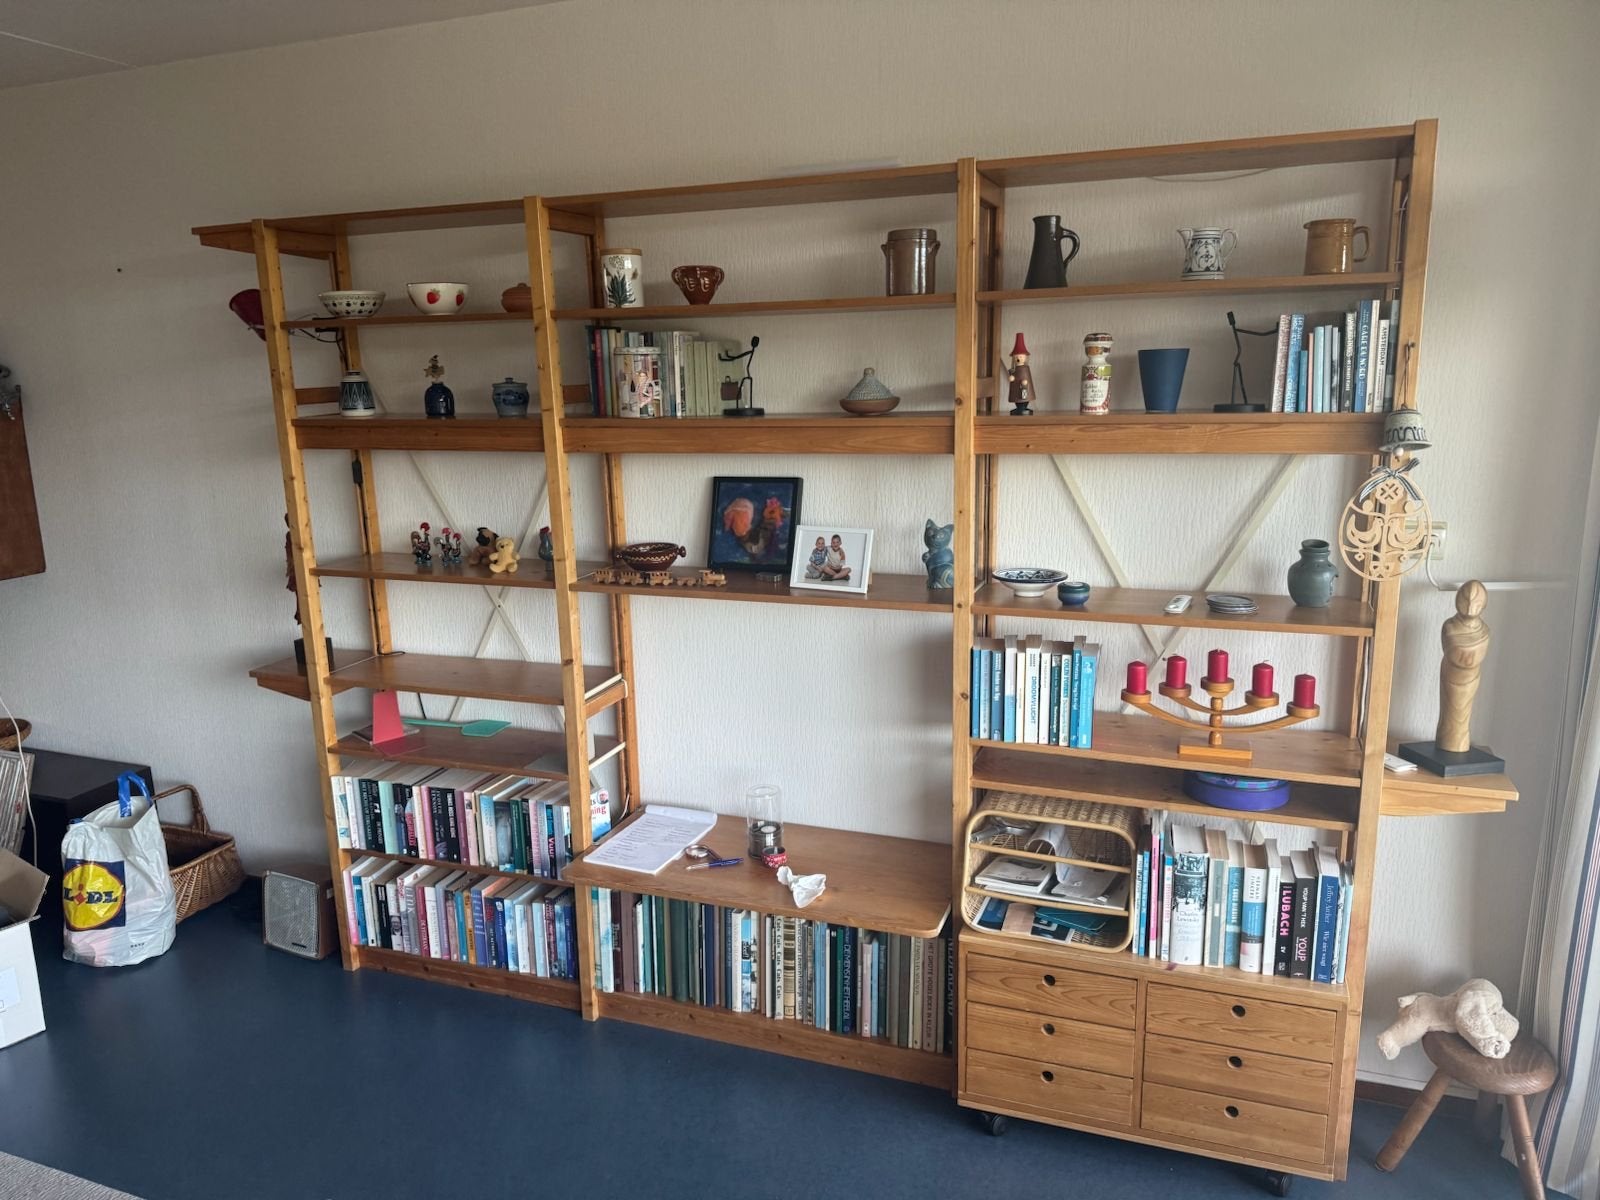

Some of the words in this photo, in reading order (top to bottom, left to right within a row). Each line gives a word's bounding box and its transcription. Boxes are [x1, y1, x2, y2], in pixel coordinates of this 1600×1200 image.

[1361, 325, 1369, 345] GARE
[1359, 358, 1367, 380] NORD
[64, 884, 118, 905] LIDL
[1326, 884, 1334, 904] Jeffrey
[1280, 890, 1292, 936] LUBACH
[1298, 937, 1308, 962] YOUP
